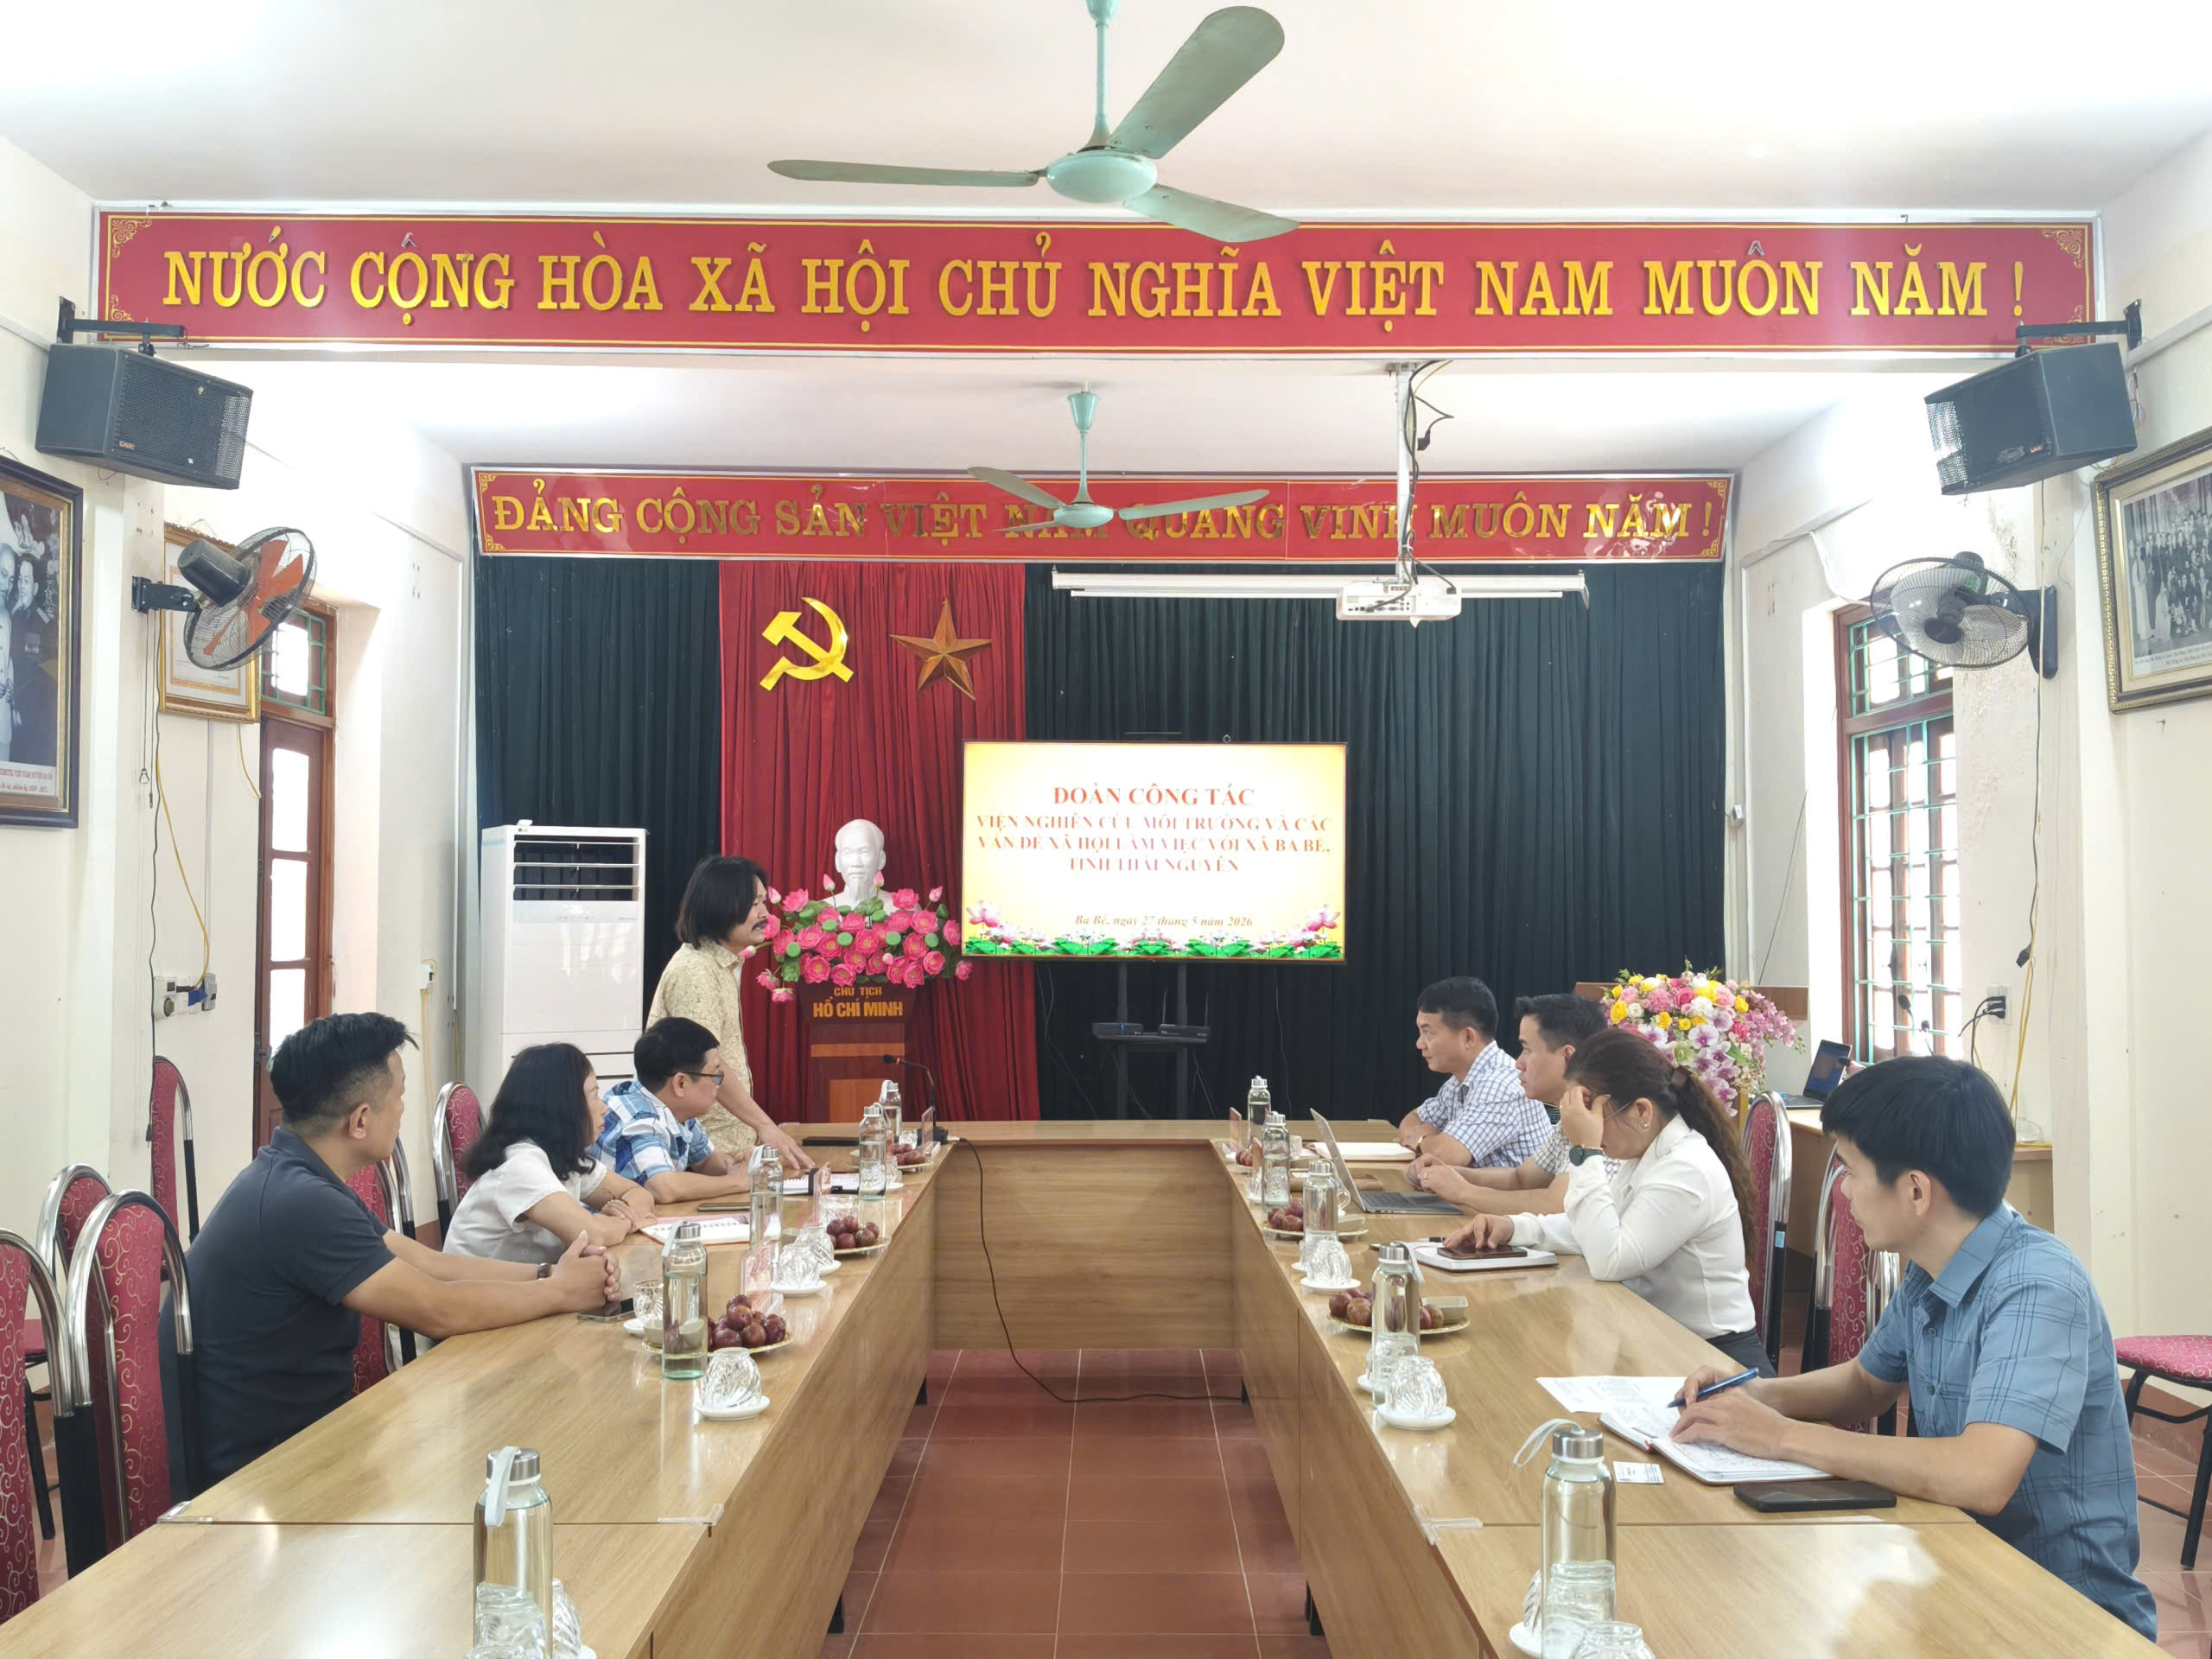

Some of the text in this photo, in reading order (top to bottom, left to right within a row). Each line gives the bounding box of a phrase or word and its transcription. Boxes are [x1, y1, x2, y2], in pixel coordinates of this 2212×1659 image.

[162, 226, 327, 308] NƯỚC
[349, 232, 516, 326] CỘNG
[537, 230, 664, 312] HÒA
[689, 242, 776, 314] XÃ
[801, 238, 910, 333] HỘI
[938, 231, 1062, 318] CHỦ
[1087, 245, 1283, 318] NGHĨA
[1301, 239, 1445, 333] VIỆT
[1474, 260, 1614, 316] NAM
[1642, 240, 1824, 316] MUÔN
[1849, 243, 1988, 316] NĂM
[492, 478, 623, 534] ĐẢNG
[636, 486, 761, 544] CỘNG
[776, 484, 868, 537] SẢN
[880, 492, 988, 546] VIỆT
[1430, 490, 1573, 539] MUÔN
[1583, 493, 1692, 538] NĂM
[1128, 782, 1198, 806] CÔNG
[1205, 783, 1255, 806] TÁC
[1275, 839, 1299, 853] BA
[1228, 916, 1254, 927] 2026
[836, 998, 861, 1017] CHÍ
[864, 1001, 903, 1017] MINH
